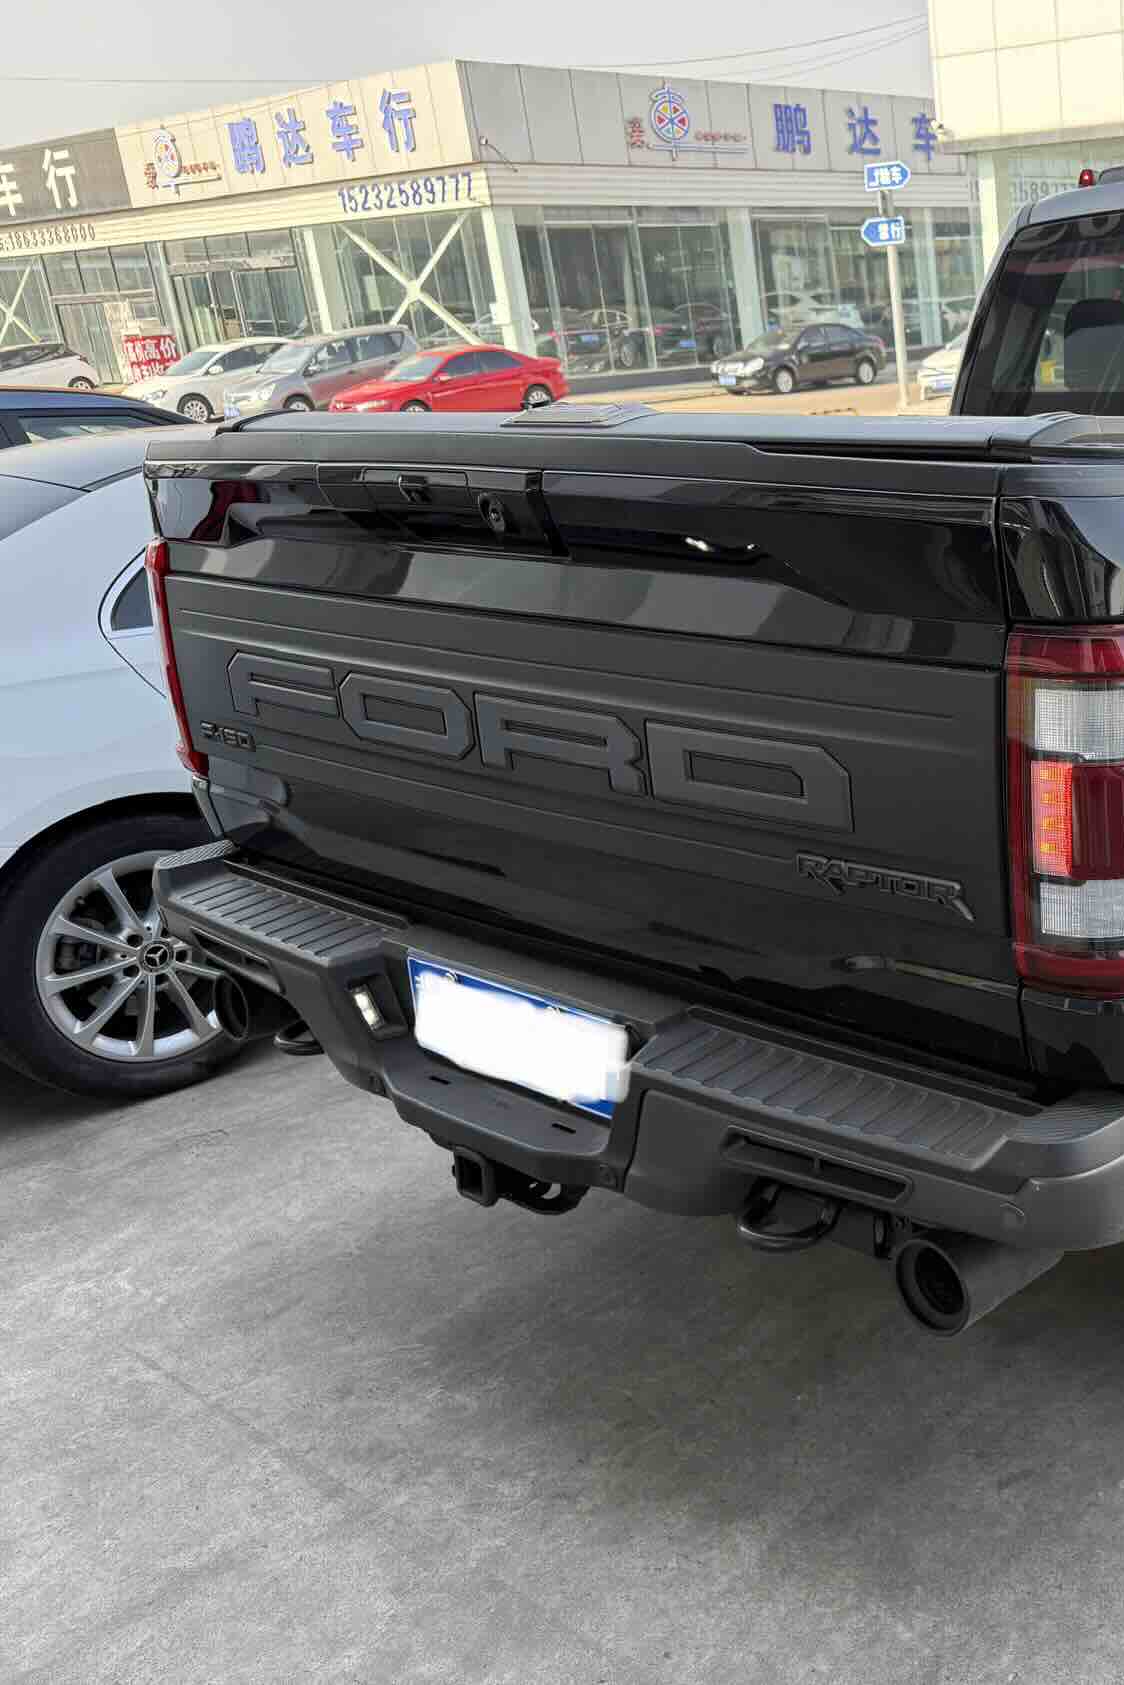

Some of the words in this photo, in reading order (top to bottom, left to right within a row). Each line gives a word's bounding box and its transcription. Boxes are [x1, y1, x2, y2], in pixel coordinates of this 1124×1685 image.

[227, 88, 417, 175] 鹏达车行
[338, 171, 473, 214] 15232589777
[227, 651, 854, 832] FORD
[797, 853, 975, 922] RAPTOR
